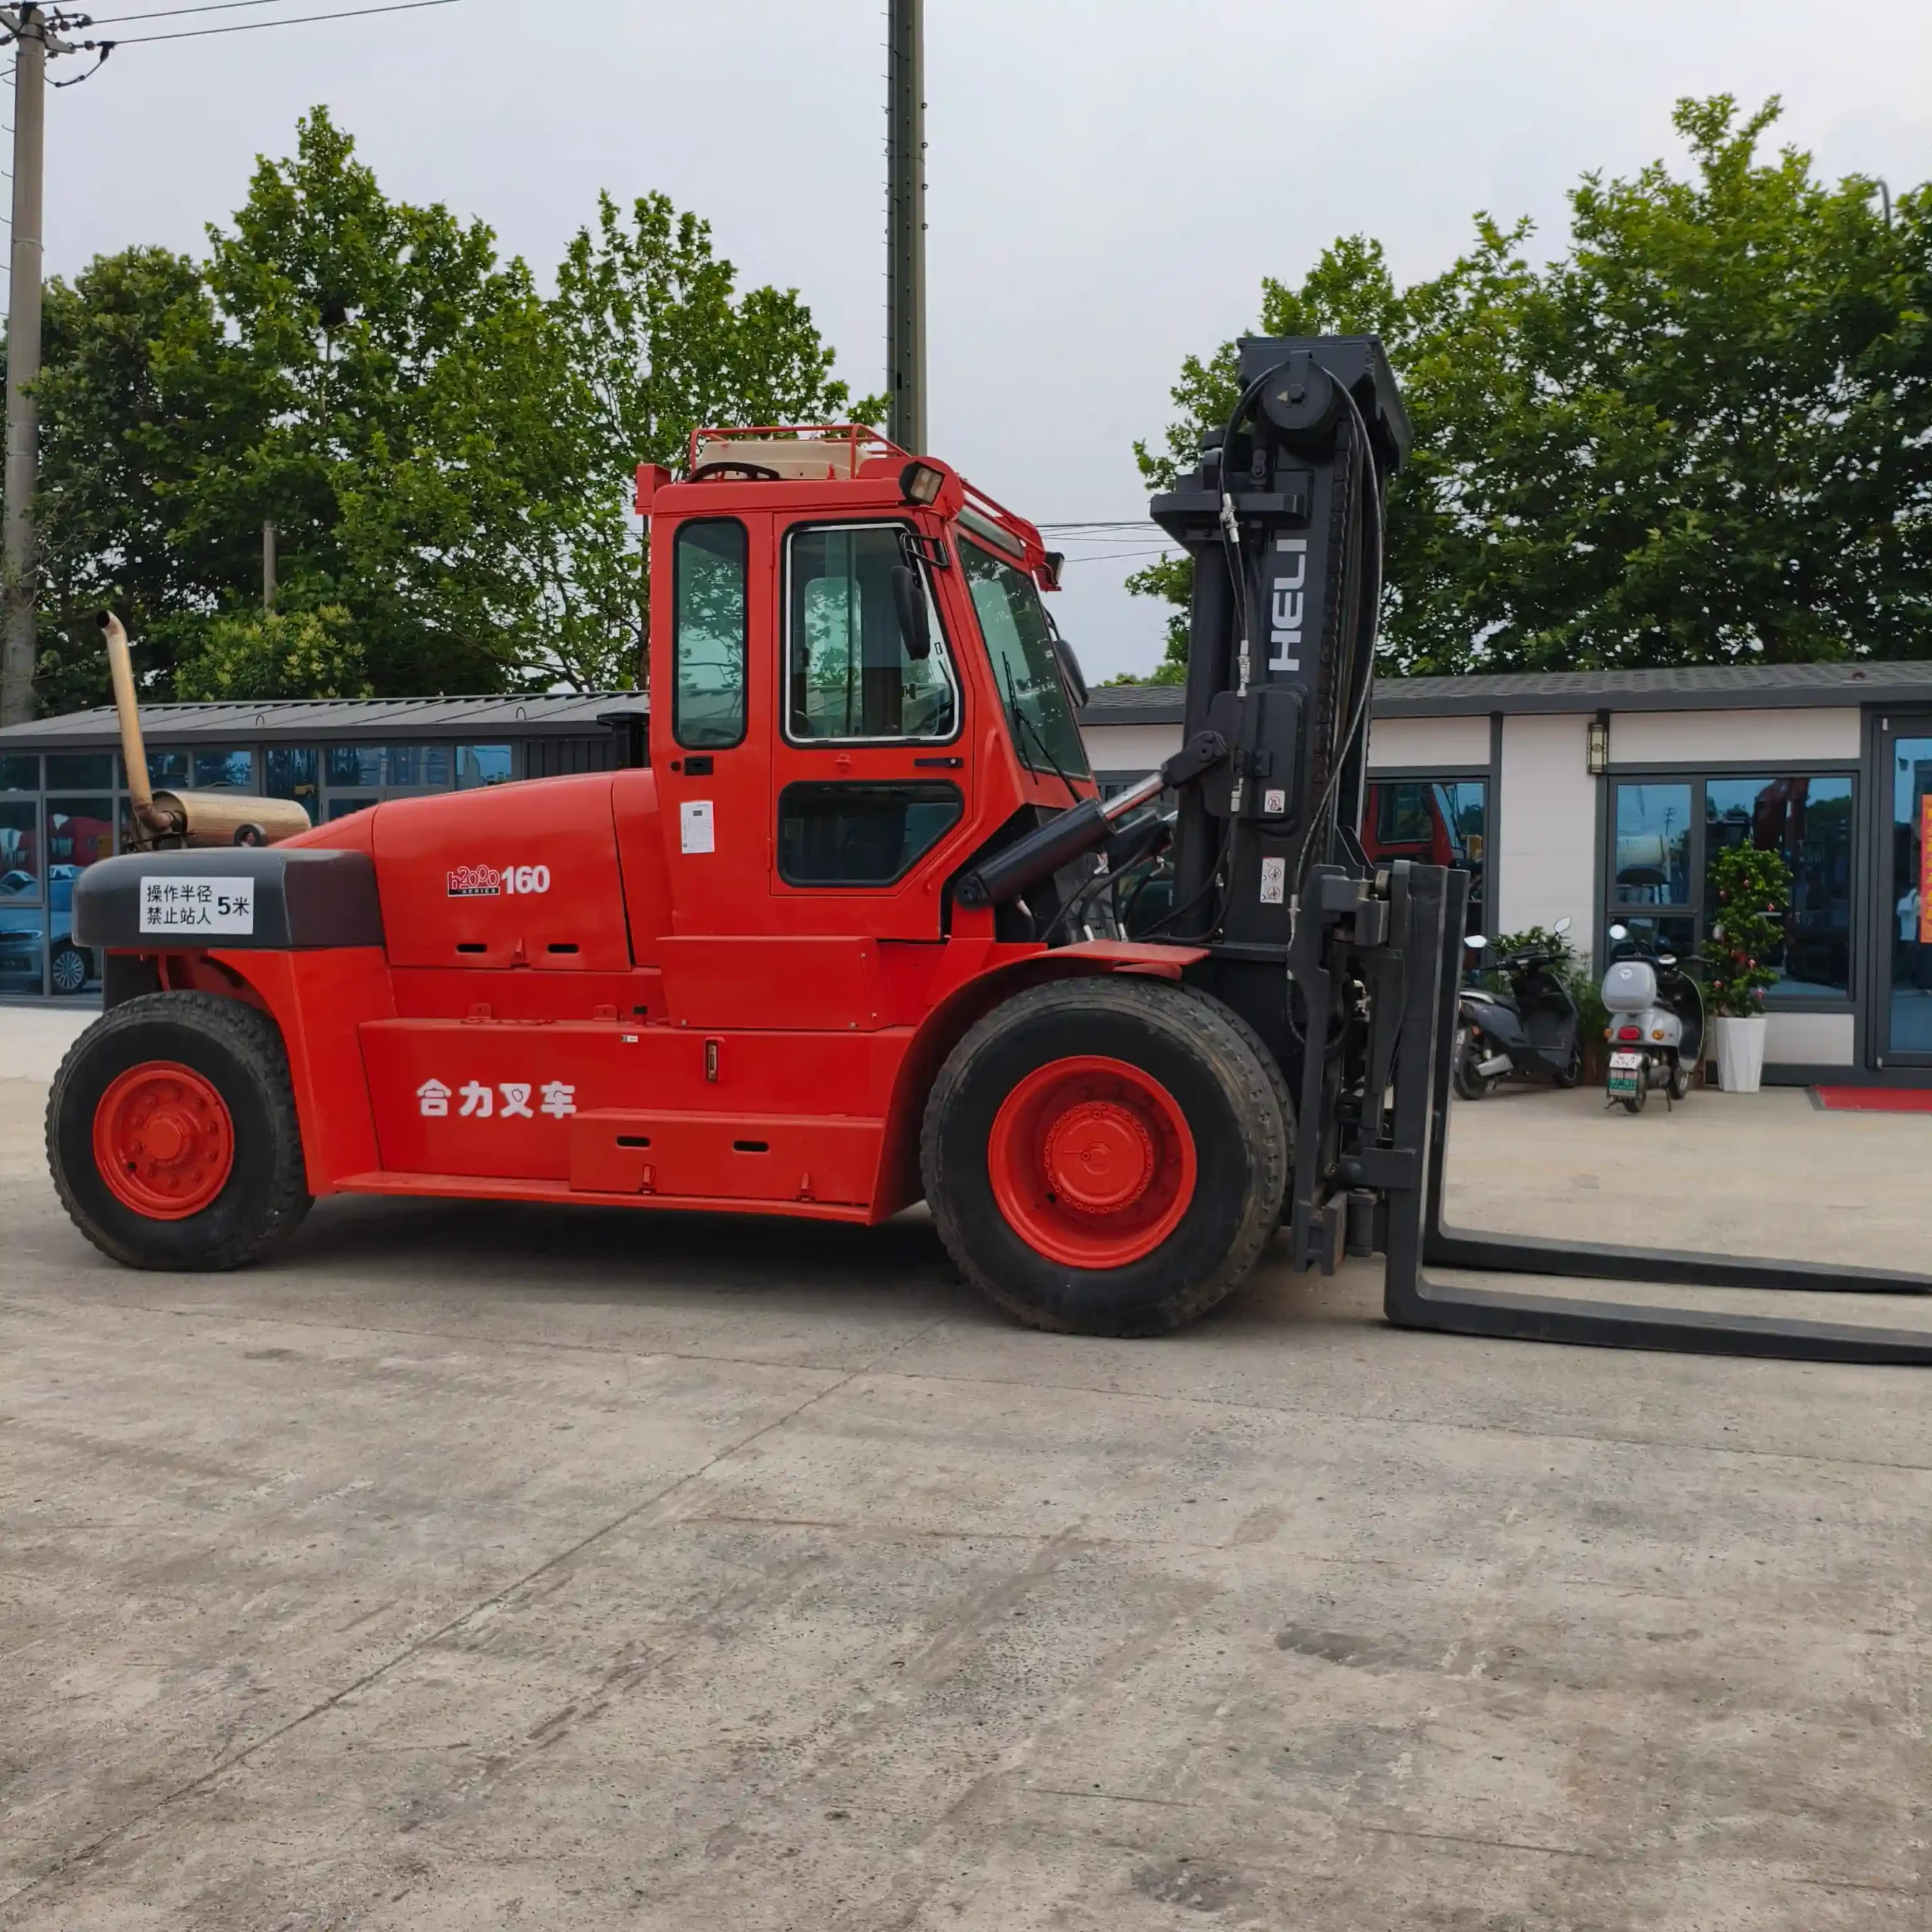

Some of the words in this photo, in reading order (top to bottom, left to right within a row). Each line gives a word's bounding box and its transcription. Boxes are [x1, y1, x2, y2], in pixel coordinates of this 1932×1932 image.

[1269, 539, 1307, 671] HELI
[501, 865, 550, 894] 160
[146, 884, 212, 903] 操作半径
[146, 906, 212, 925] 禁止站人
[217, 896, 250, 916] 5米
[417, 1078, 577, 1118] 合力叉车
